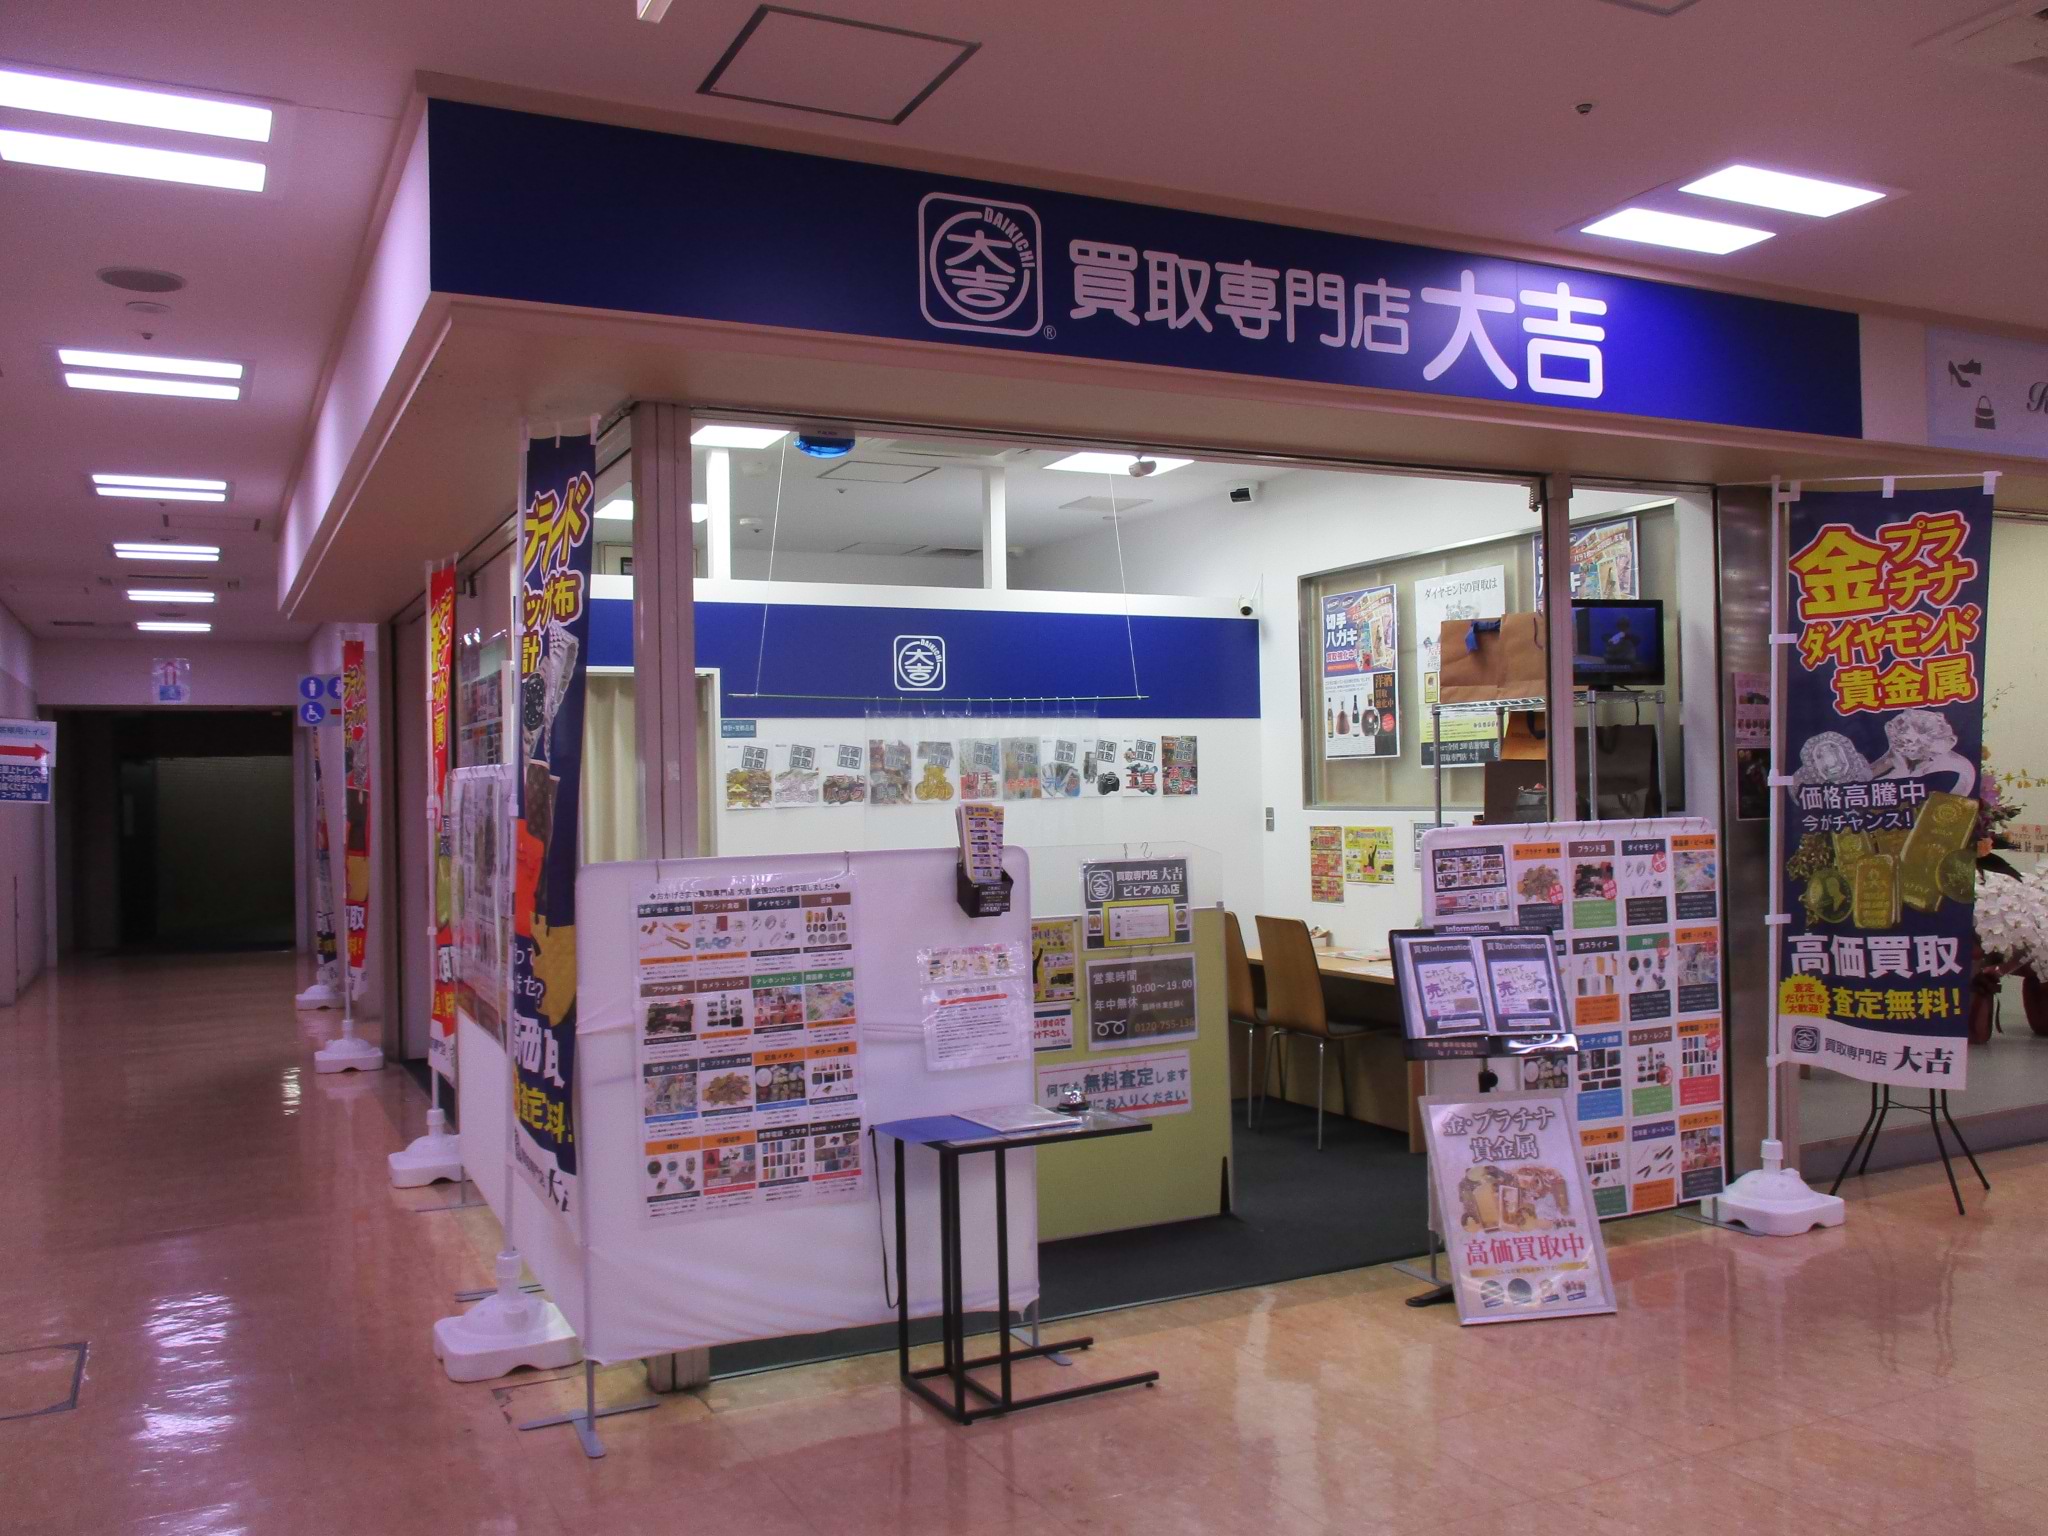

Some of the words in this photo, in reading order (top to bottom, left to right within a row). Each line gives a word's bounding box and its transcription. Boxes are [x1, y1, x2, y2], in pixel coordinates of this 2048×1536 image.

[981, 205, 1037, 268] DAIKICHI
[945, 228, 1016, 308] 大吉
[1068, 237, 1411, 356] 買取専門店
[1420, 269, 1609, 399] 大吉
[1883, 518, 1963, 565] プラ
[1792, 528, 1889, 617] 金
[1424, 577, 1498, 599] ダイヤモンドの買取は
[1892, 560, 1970, 606] チナ
[1326, 612, 1347, 630] 切手
[1326, 628, 1358, 648] ハガキ
[1802, 610, 1975, 666] ダイヤモンド
[904, 648, 935, 681] 大吉
[1837, 657, 1972, 711] 貴金属
[744, 748, 765, 758] 高価
[793, 747, 814, 757] 高価
[839, 747, 862, 757] 高価
[1136, 740, 1155, 751] 高価
[743, 758, 765, 769] 買取
[792, 757, 813, 768] 買取
[839, 757, 860, 768] 買取
[1135, 751, 1154, 761] 買取
[1125, 772, 1157, 790] 工具
[1800, 780, 1926, 811] 価格高騰中
[1801, 809, 1914, 832] 今がチャンス!
[1578, 844, 1606, 853] ブランド品
[1627, 842, 1661, 851] ダイヤモンド
[1116, 870, 1158, 881] 買取専門店
[1161, 867, 1183, 881] 大吉
[757, 899, 792, 908] ダイヤモンド
[1445, 924, 1490, 933] Information
[1578, 940, 1614, 950] ガスライター
[1787, 932, 1963, 979] 高価買取
[1093, 969, 1137, 985] 営業時間
[1424, 966, 1452, 979] これって
[1497, 964, 1525, 977] これって
[702, 979, 745, 989] カメラ・レンズ
[756, 976, 797, 985] テレホンカード
[1094, 996, 1138, 1012] 年中無休
[1785, 993, 1826, 1004] だけでも
[1833, 987, 1962, 1020] 査定無料!
[1631, 1031, 1669, 1041] カメラ・レンズ
[1825, 1036, 1888, 1067] 買取専門店
[1894, 1045, 1954, 1075] 大吉
[1442, 1105, 1556, 1137] 金・プラチナ
[1469, 1133, 1540, 1164] 貴金属
[1465, 1232, 1586, 1267] 高価買取中
